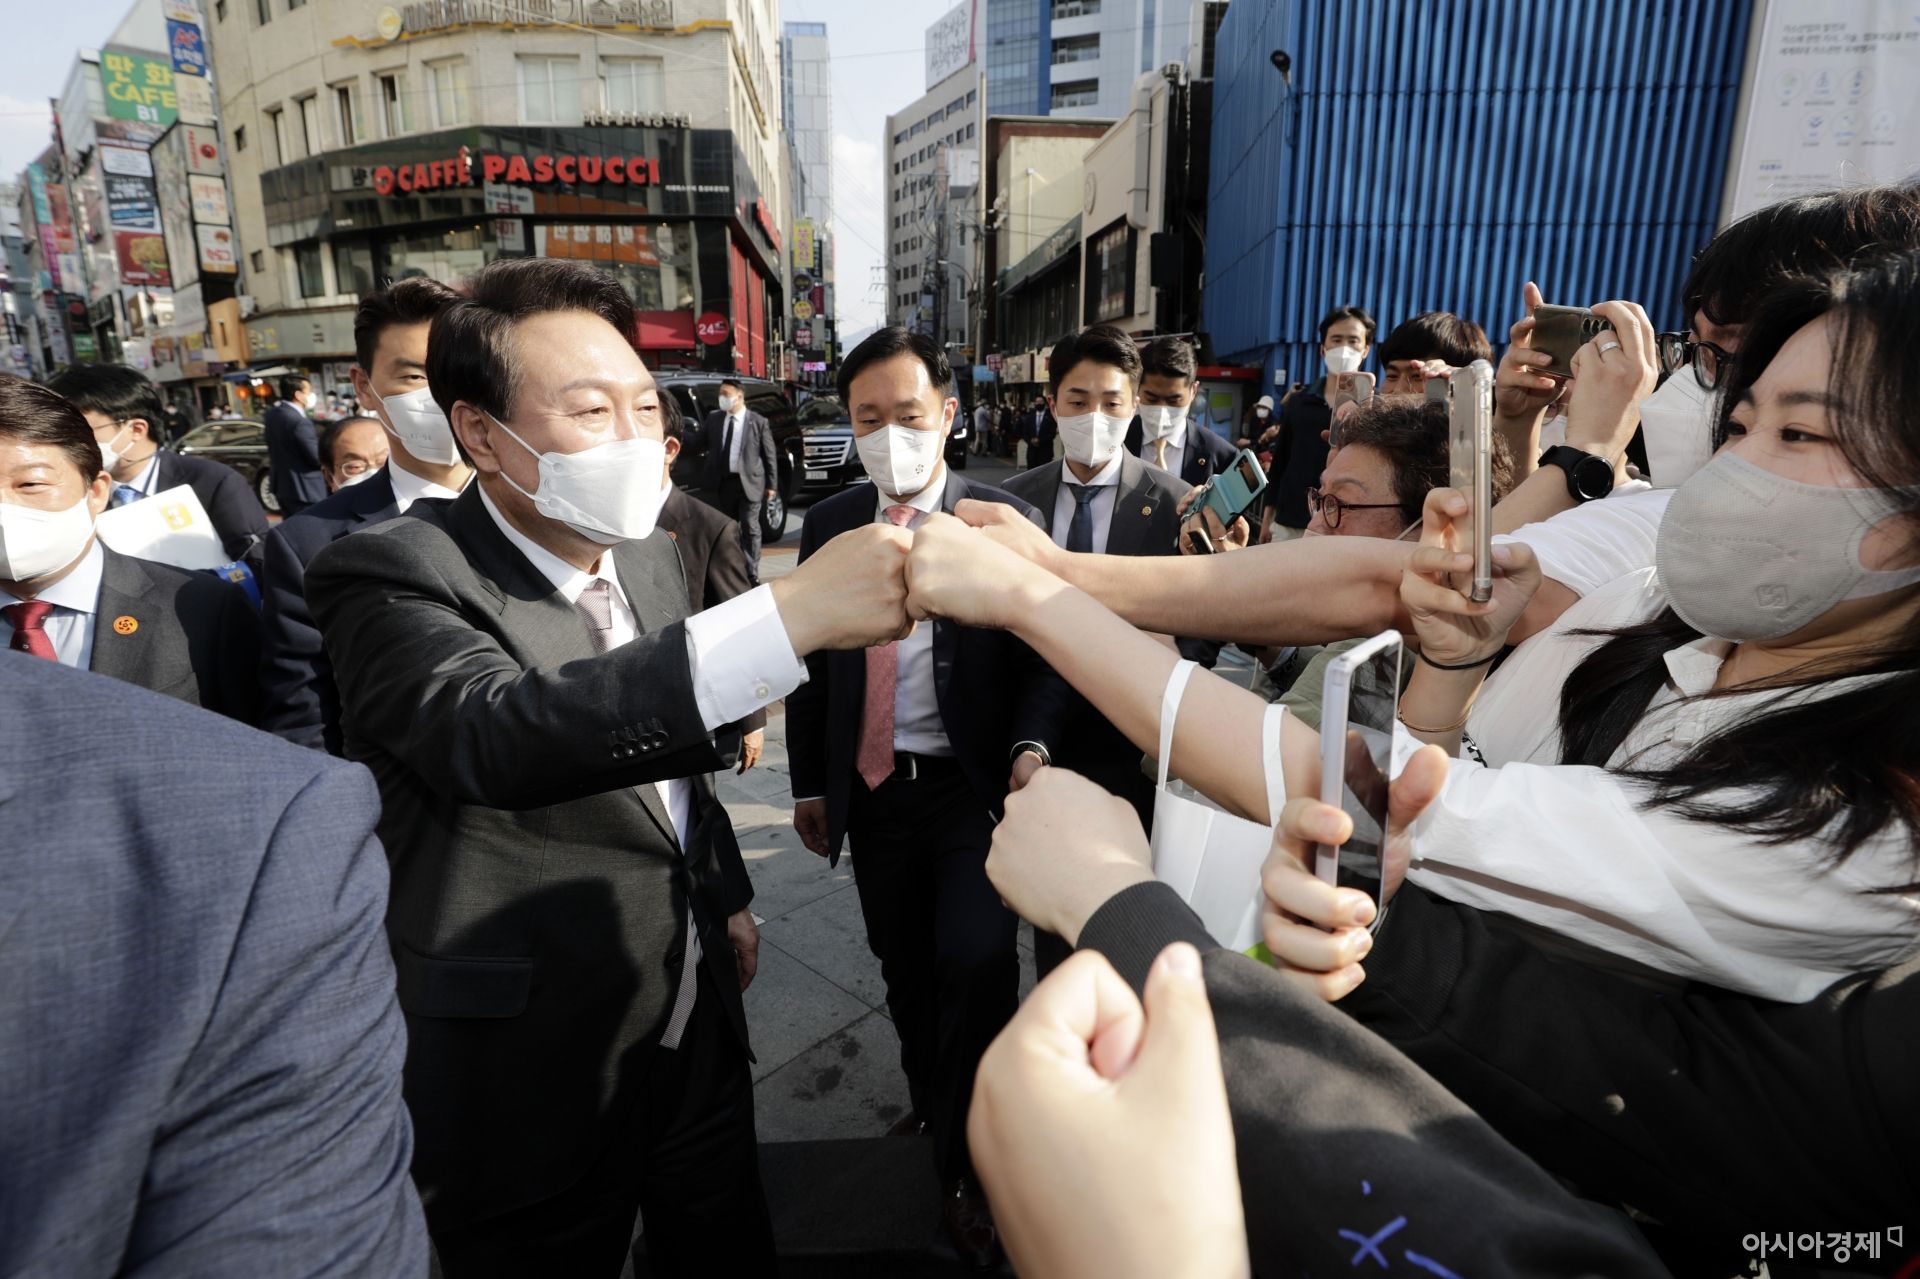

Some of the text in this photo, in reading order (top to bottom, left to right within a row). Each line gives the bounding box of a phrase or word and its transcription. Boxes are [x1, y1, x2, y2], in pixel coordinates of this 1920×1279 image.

[107, 81, 178, 109] CAFE
[136, 103, 159, 122] B1
[483, 155, 660, 184] PASCUCCI
[698, 323, 714, 335] 24
